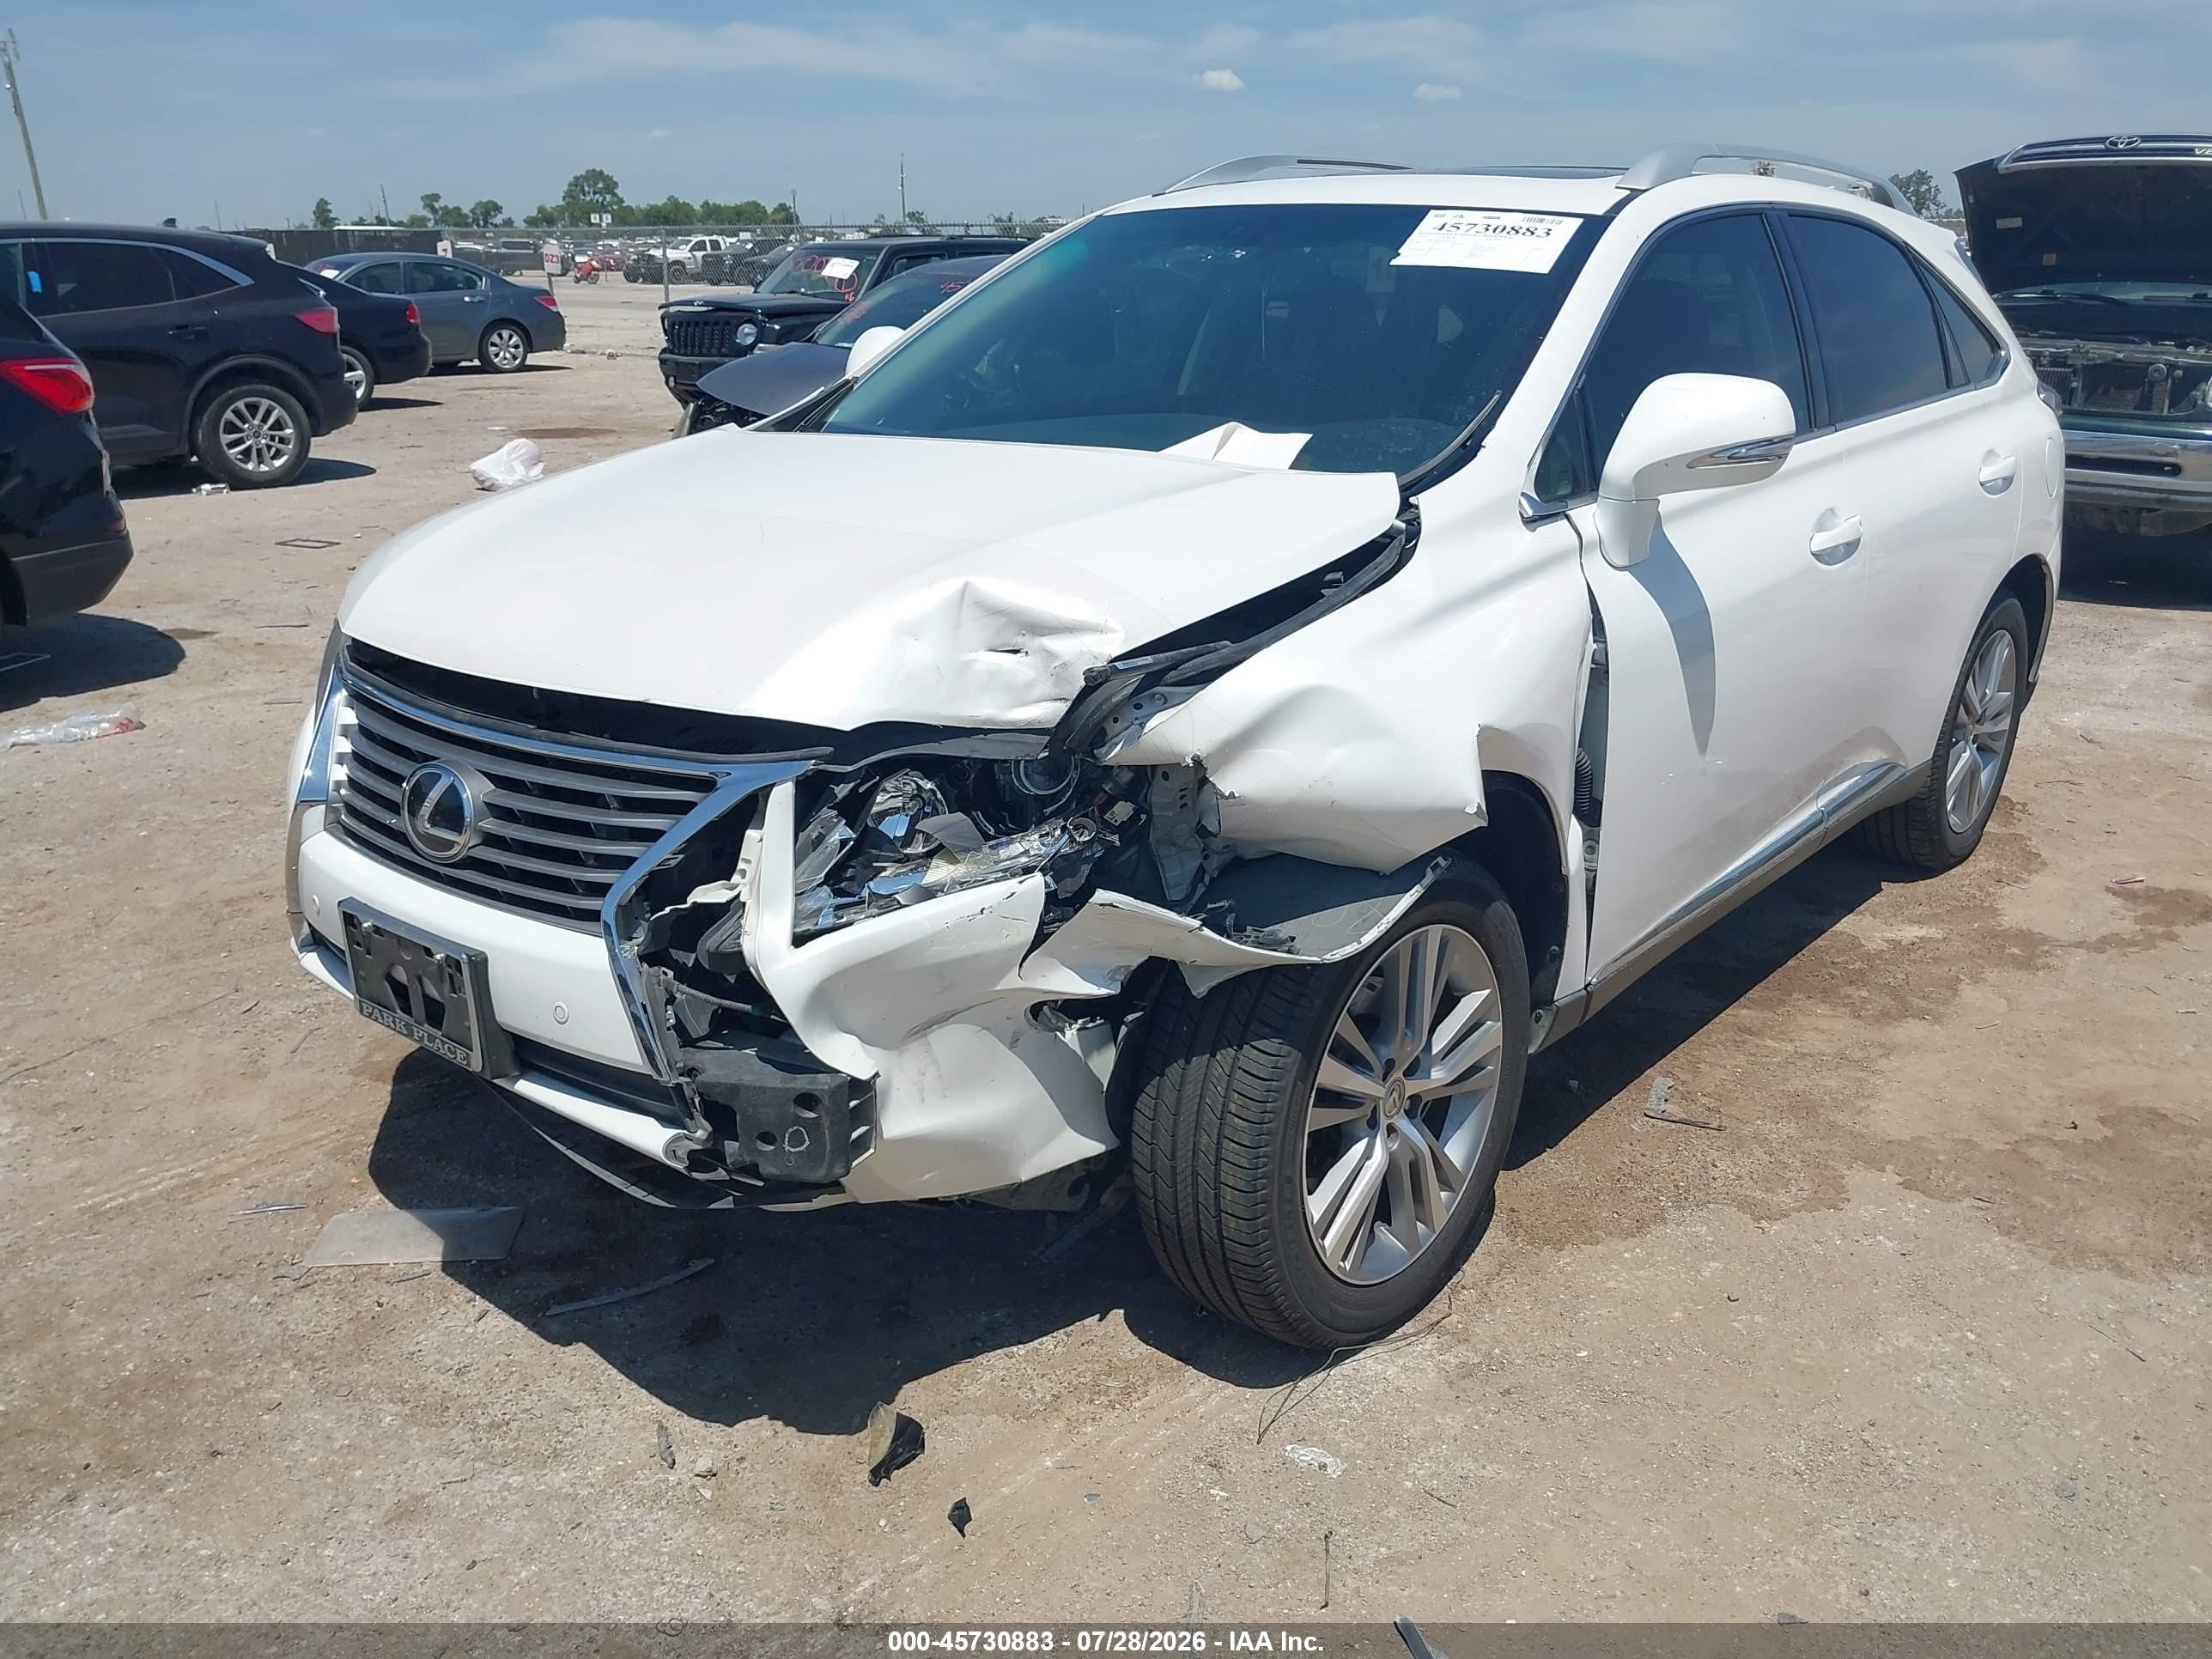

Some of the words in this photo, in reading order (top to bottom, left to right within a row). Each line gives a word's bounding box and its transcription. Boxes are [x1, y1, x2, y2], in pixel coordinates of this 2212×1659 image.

[1432, 222, 1553, 239] 45730883
[362, 1002, 409, 1036] PARK
[413, 1027, 468, 1066] PLACE
